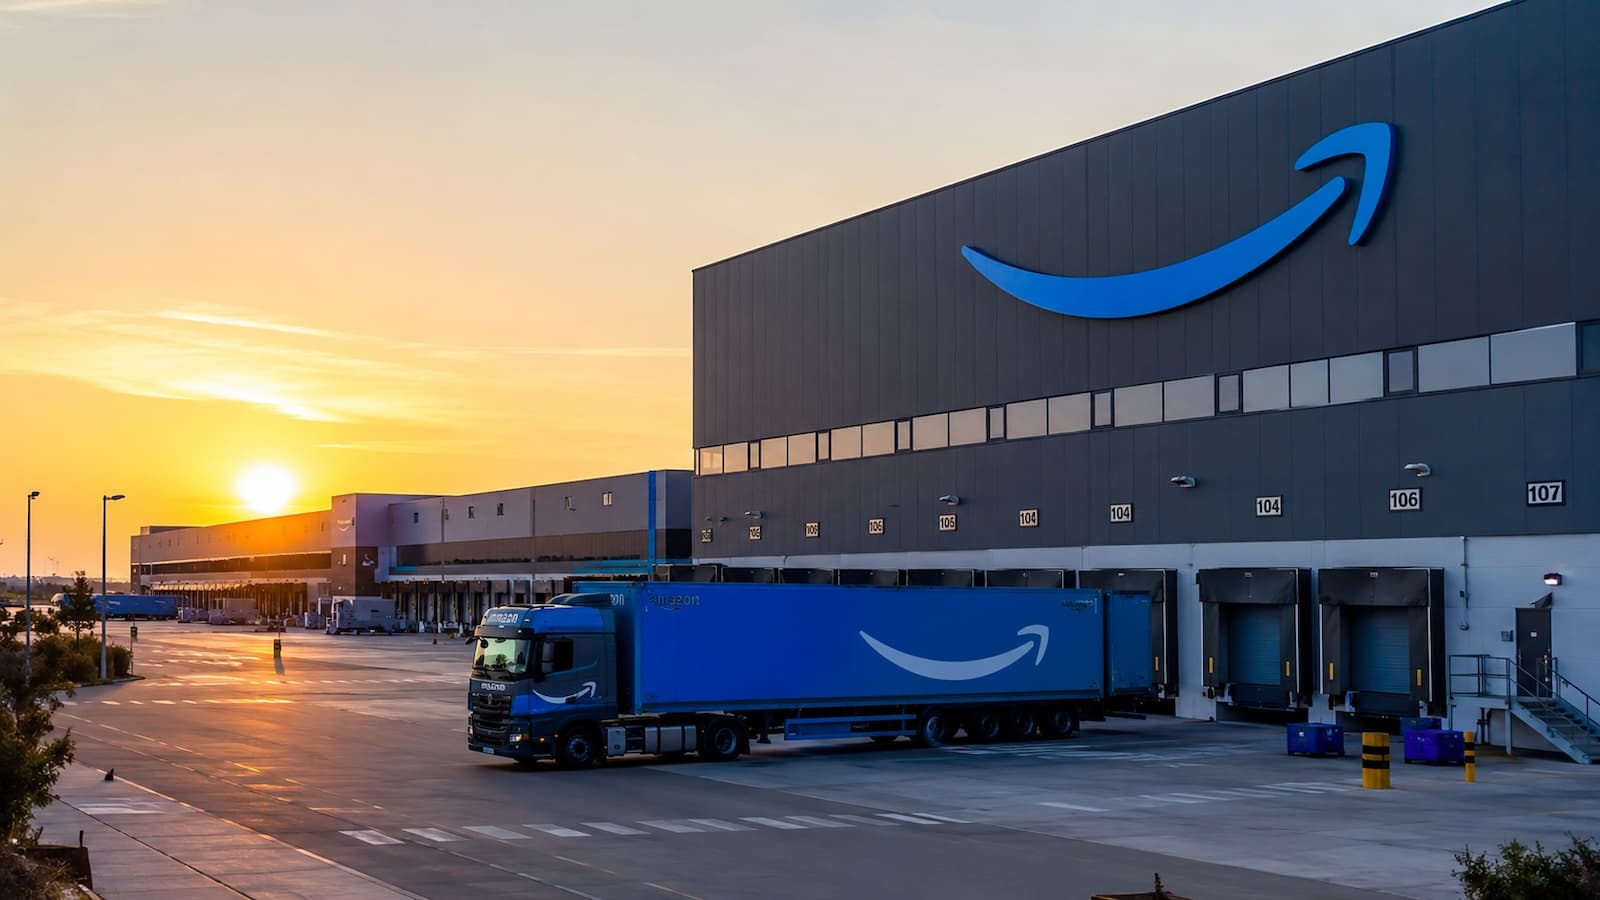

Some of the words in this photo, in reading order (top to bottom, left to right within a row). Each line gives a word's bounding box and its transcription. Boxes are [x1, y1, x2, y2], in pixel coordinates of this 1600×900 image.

[1391, 492, 1417, 508] 106
[1528, 485, 1560, 502] 107
[1111, 506, 1130, 520] 104
[1257, 499, 1280, 513] 104
[1021, 511, 1036, 524] 104
